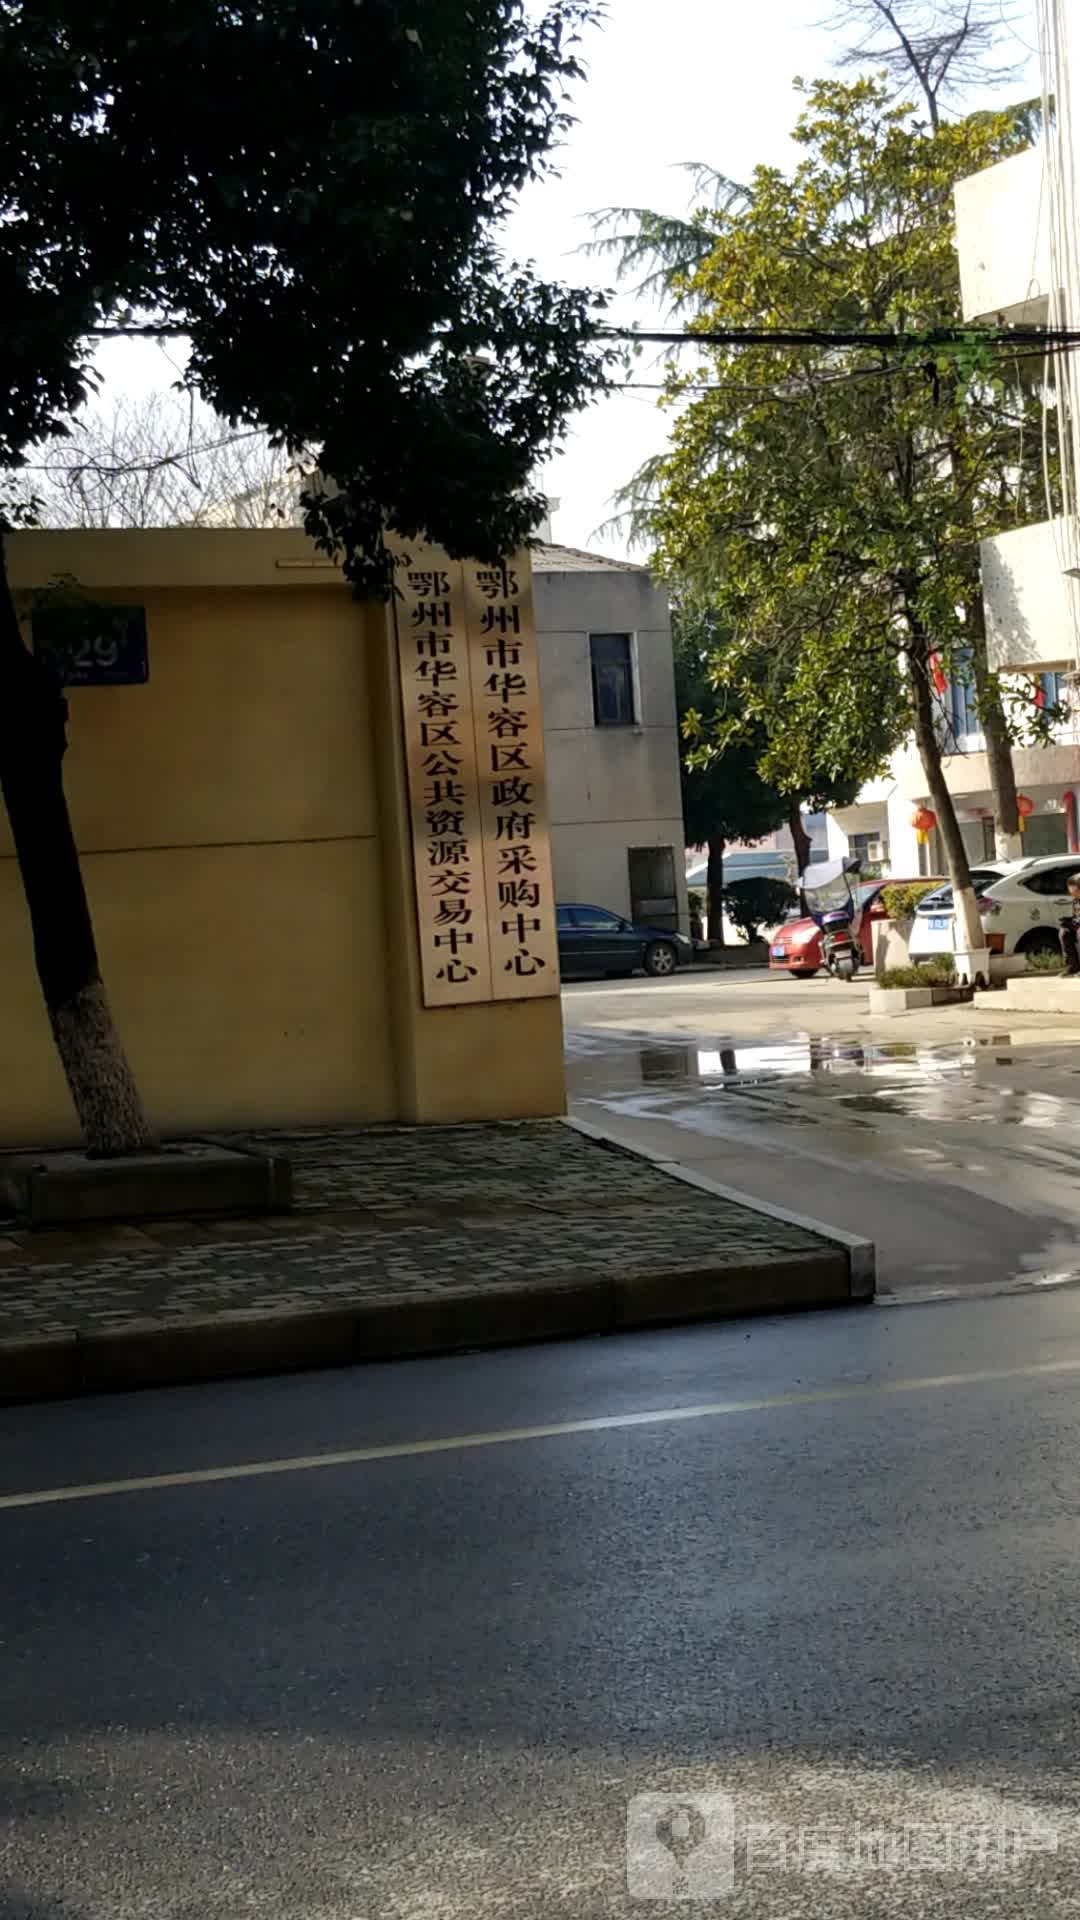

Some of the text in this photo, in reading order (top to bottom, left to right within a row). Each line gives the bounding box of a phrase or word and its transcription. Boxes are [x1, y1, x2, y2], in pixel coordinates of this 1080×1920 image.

[408, 571, 477, 983] 鄂州市华容区公共资源交易中心
[476, 569, 545, 976] 鄂州市华容区政府采购中心
